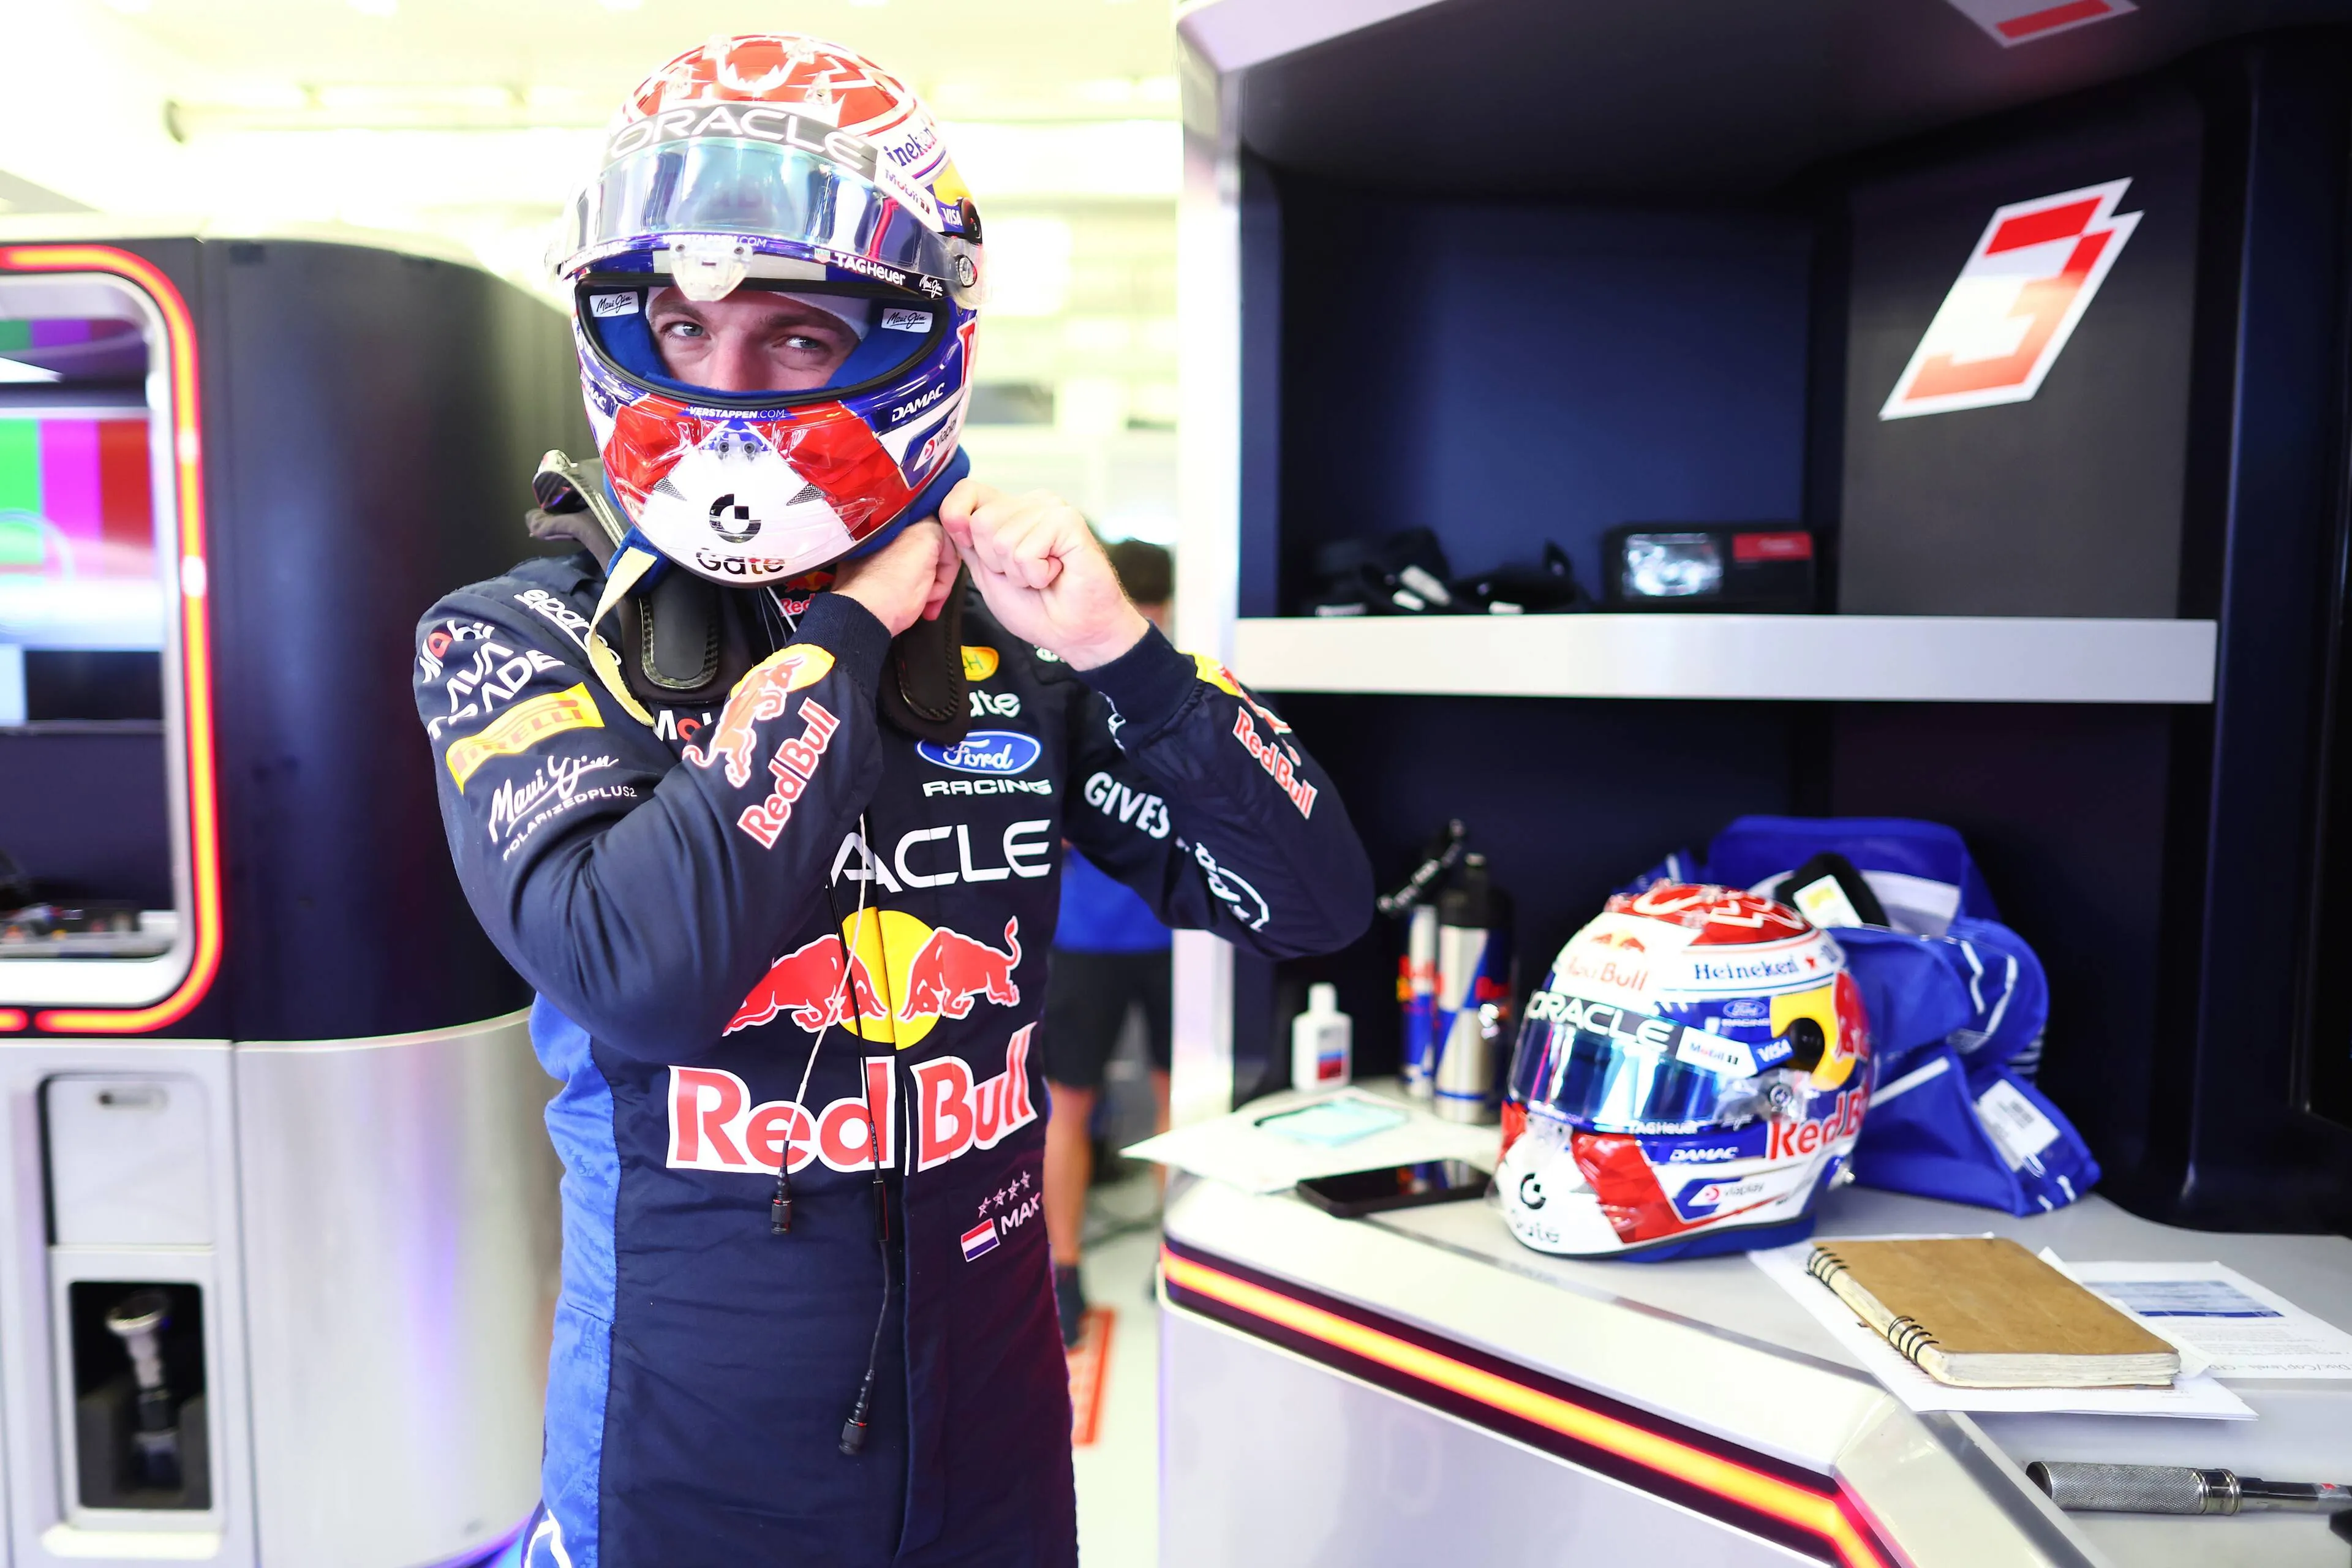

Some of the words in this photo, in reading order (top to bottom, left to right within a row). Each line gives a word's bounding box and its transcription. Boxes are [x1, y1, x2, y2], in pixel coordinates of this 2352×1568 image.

[612, 105, 863, 168] ORACLE
[941, 207, 963, 227] VISA
[596, 297, 614, 312] Maui
[887, 313, 907, 325] Maui
[688, 406, 786, 419] VERSTAPPEN.COM
[892, 382, 945, 422] DAMAC
[696, 551, 785, 575] Gate
[451, 699, 584, 775] PIRELLI
[943, 739, 1014, 770] Ford
[489, 768, 548, 843] Maui
[547, 755, 619, 800] Jim
[922, 778, 1054, 797] RACING
[1084, 771, 1171, 839] GIVES
[829, 819, 1052, 893] ACLE
[1600, 962, 1648, 991] Bull
[1694, 959, 1799, 980] Heineken
[1526, 990, 1674, 1053] ORACLE
[1757, 1039, 1792, 1063] VISA
[666, 1055, 895, 1175] Red
[909, 1021, 1038, 1173] Bull
[1669, 1147, 1740, 1162] DAMAC
[1001, 1192, 1041, 1235] MAX
